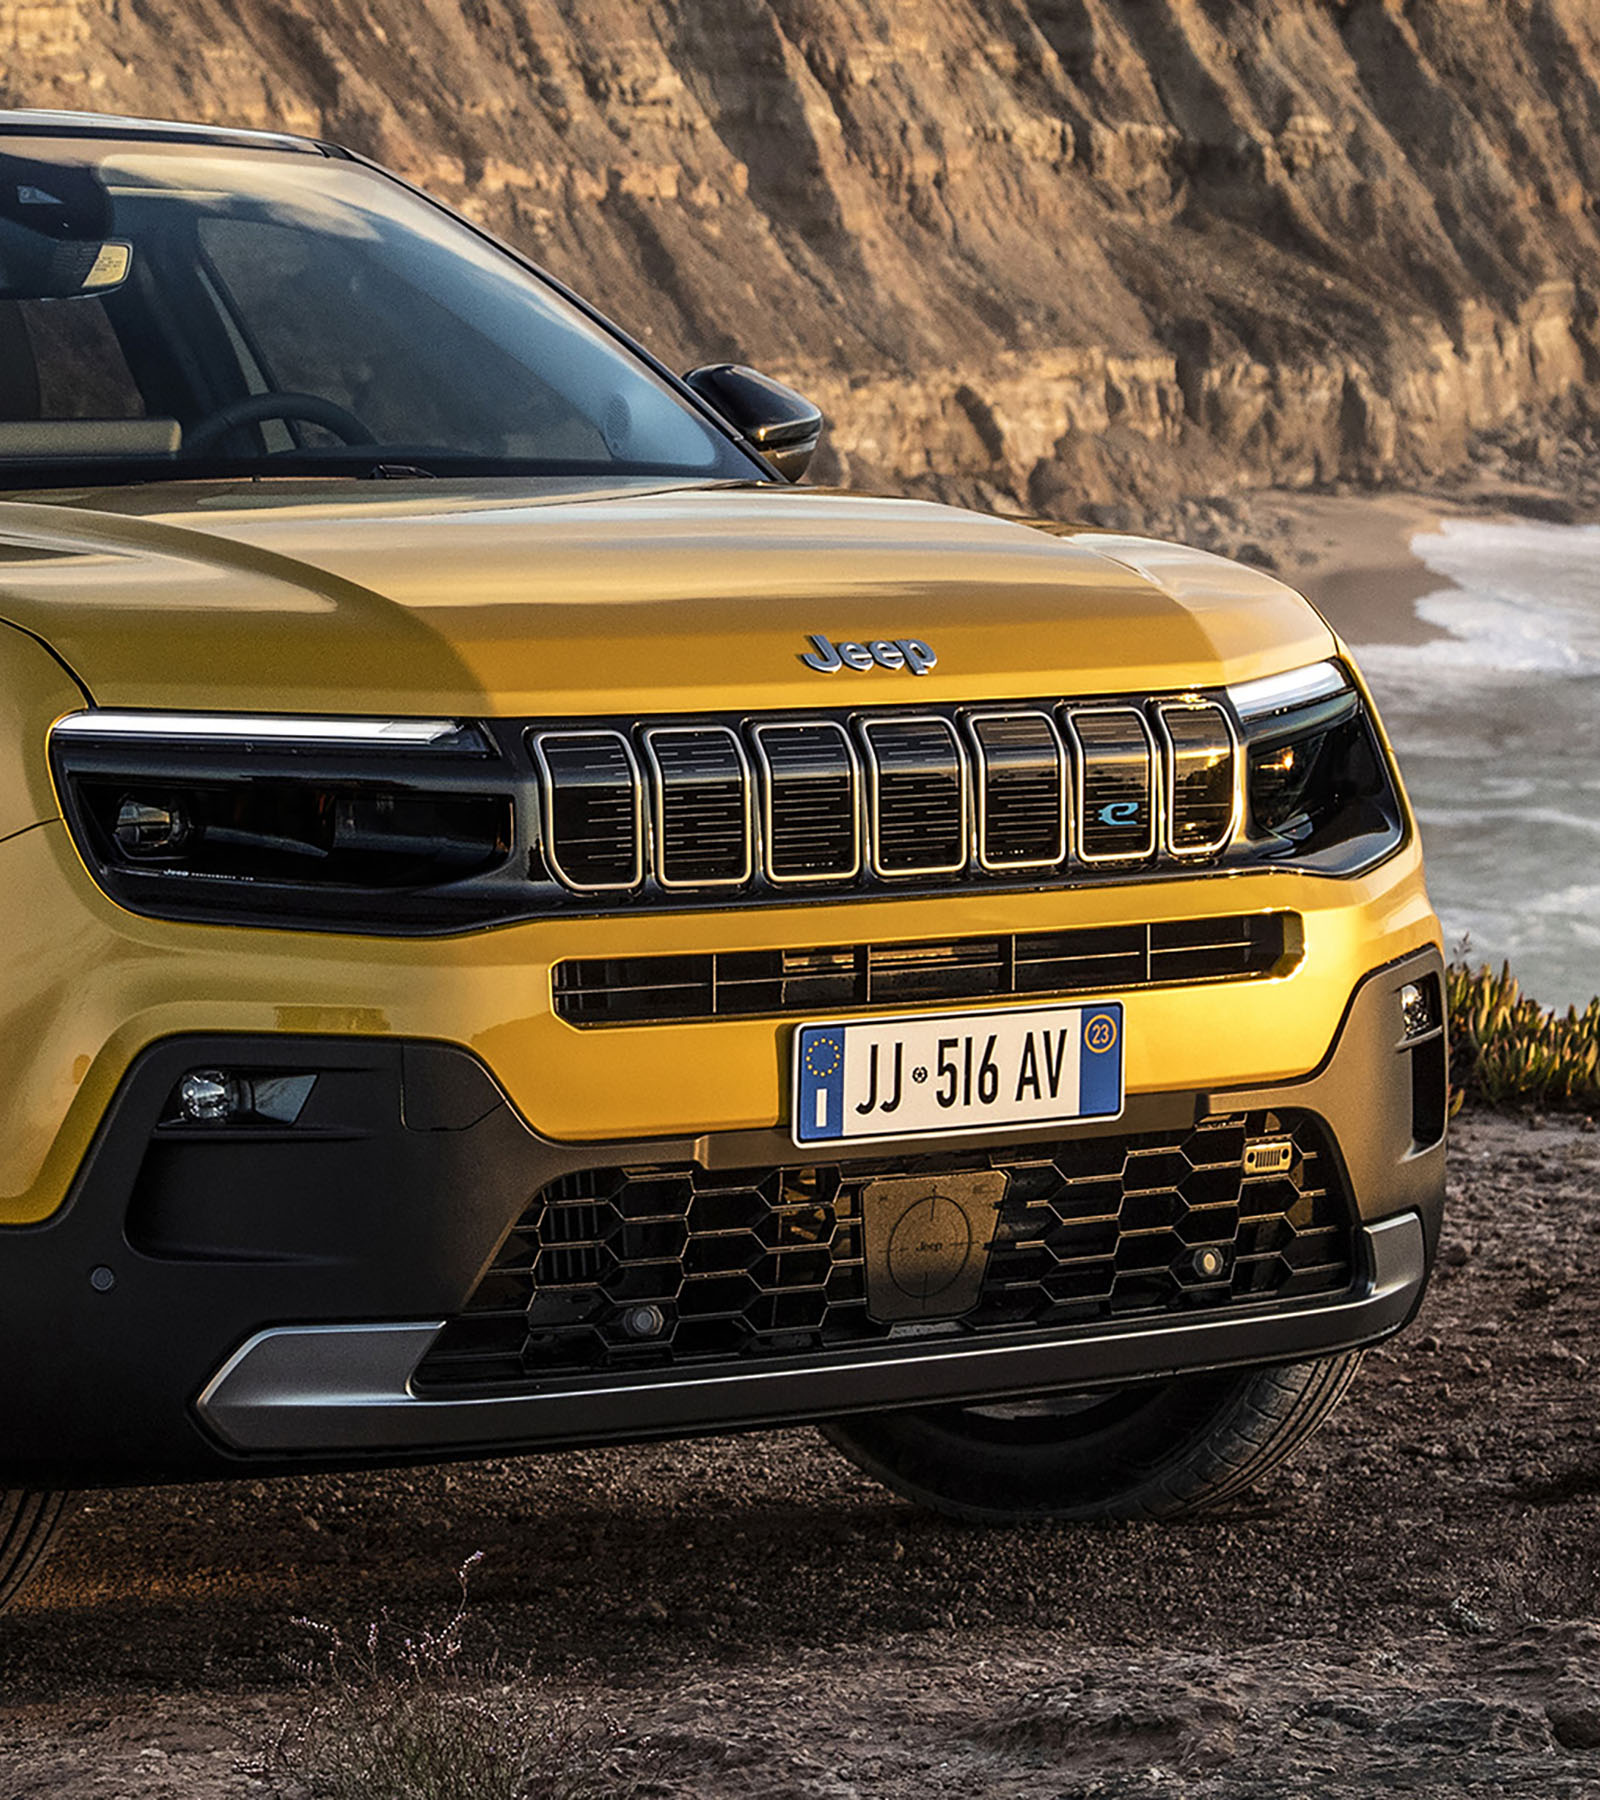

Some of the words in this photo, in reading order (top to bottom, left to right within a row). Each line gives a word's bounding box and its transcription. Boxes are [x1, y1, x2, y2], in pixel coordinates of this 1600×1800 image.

[802, 634, 938, 676] Jeep
[816, 1088, 828, 1128] I
[855, 1042, 903, 1115] JJ
[935, 1034, 999, 1109] 516
[1015, 1028, 1068, 1102] AV
[1092, 1024, 1109, 1044] 23
